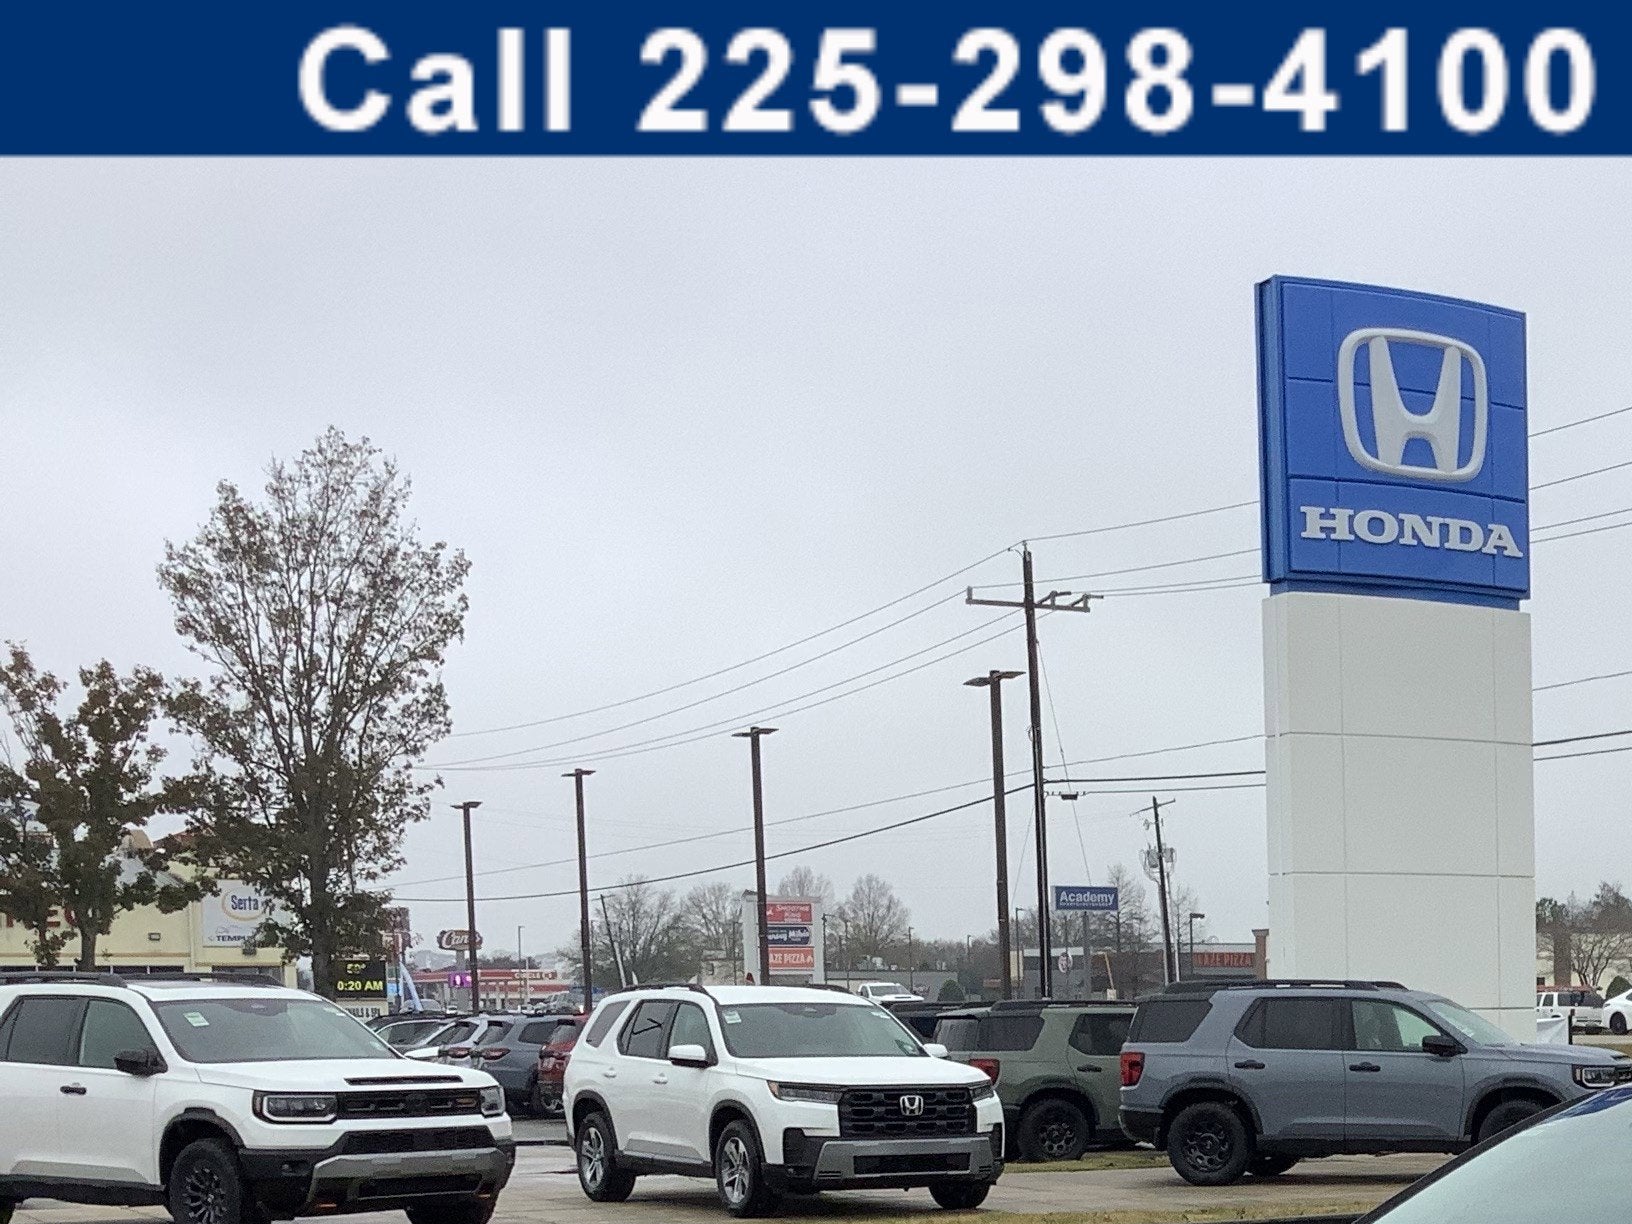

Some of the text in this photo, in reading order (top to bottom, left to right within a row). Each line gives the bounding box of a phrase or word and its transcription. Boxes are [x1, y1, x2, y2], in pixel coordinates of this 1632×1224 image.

[1300, 505, 1524, 558] HONDA
[230, 894, 259, 911] Serta
[1059, 890, 1115, 906] Academy
[784, 953, 805, 965] PIZZA
[336, 980, 384, 991] 0:20 AM
